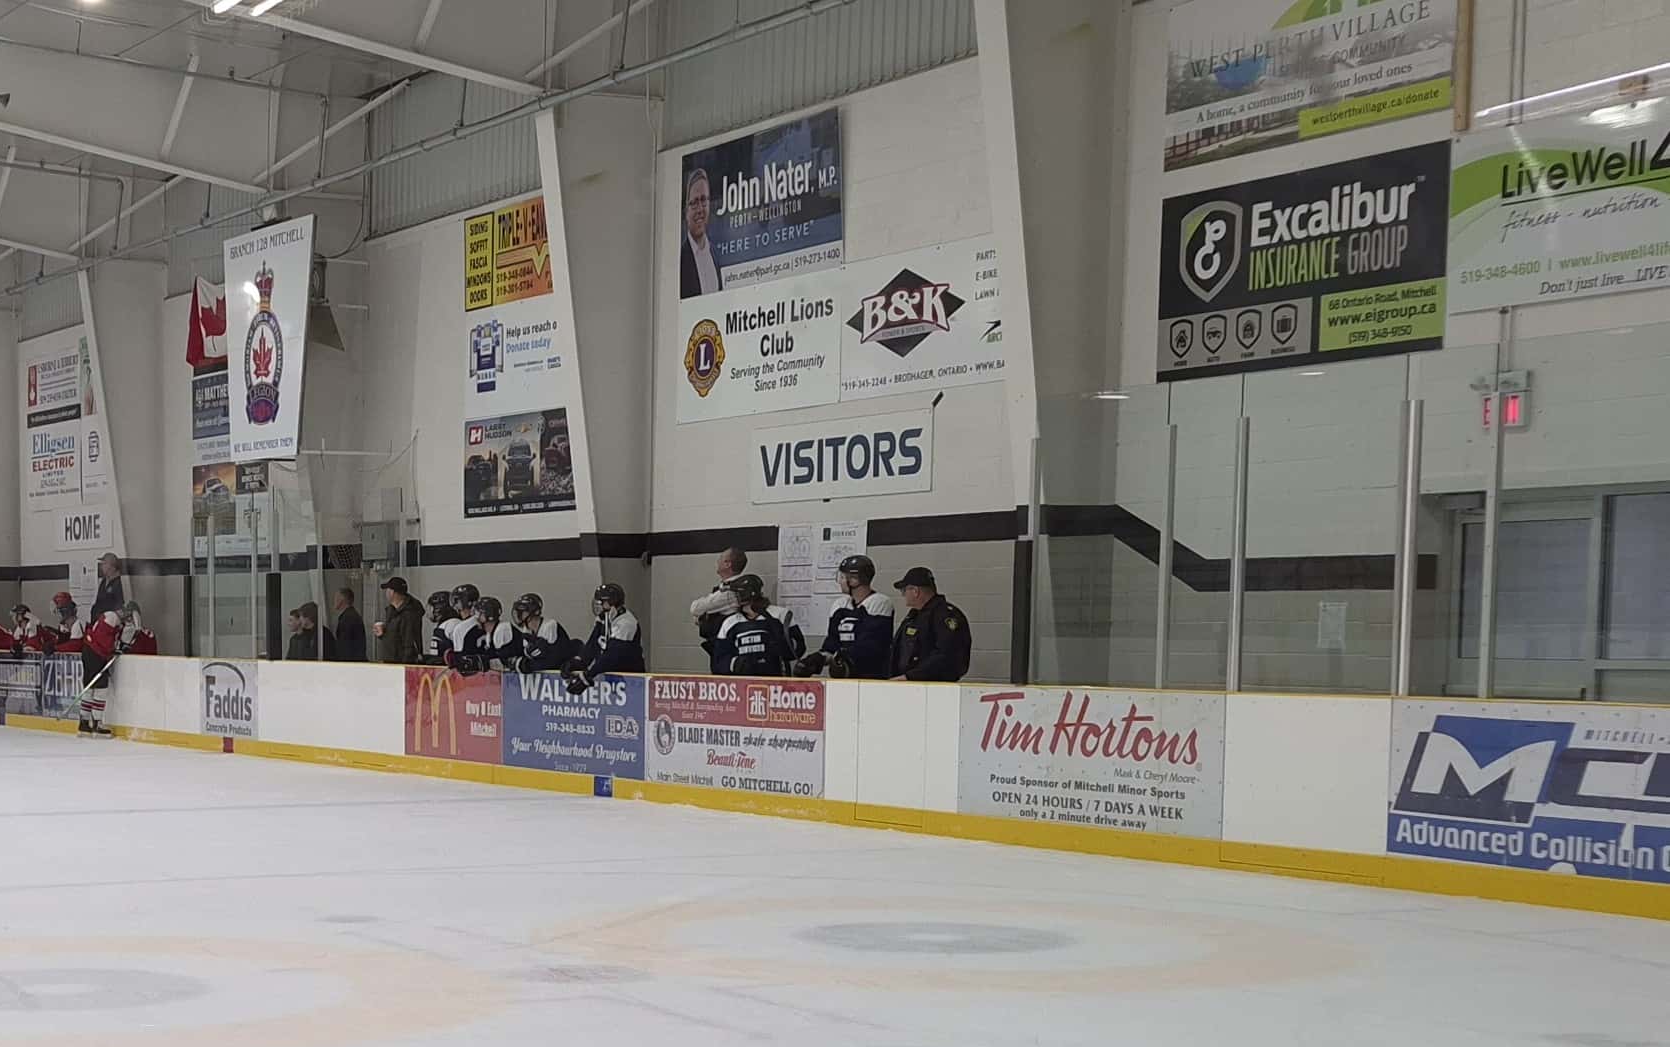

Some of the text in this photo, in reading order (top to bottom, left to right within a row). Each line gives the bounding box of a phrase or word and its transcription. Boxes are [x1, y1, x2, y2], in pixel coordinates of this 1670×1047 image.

[1190, 44, 1245, 78] WEST
[1330, 0, 1430, 41] VILLAGE
[1196, 112, 1205, 124] A
[1247, 88, 1307, 114] community
[1353, 68, 1384, 86] loved
[1386, 62, 1413, 78] ones
[717, 171, 760, 216] John
[818, 166, 838, 190] M.P.
[1250, 181, 1416, 247] Excalibur
[230, 240, 255, 260] BRANCH
[270, 226, 305, 248] MITCHELL
[755, 232, 770, 246] TO
[1248, 225, 1409, 291] INSURANCE GROUP
[1341, 293, 1374, 309] Ontario
[1401, 284, 1437, 302] Mitchell
[1576, 275, 1599, 294] just
[725, 298, 834, 335] Mitchell Lions
[860, 283, 951, 344] B&K
[1327, 302, 1437, 328] www.eigroup.ca
[506, 325, 521, 339] Help
[522, 326, 531, 336] us
[532, 320, 551, 334] reach
[698, 343, 711, 371] L
[760, 331, 794, 357] Club
[730, 353, 826, 379] Serving the Community
[938, 363, 967, 377] ONTARIO
[251, 382, 277, 399] LEGION
[754, 374, 798, 392] Since 1936
[32, 431, 75, 457] Elligsen
[760, 427, 923, 487] VISITORS
[32, 456, 75, 472] ELECTRIC
[65, 514, 100, 541] HOME
[205, 675, 252, 722] Faddis
[654, 680, 740, 702] FAUST BROS.
[769, 685, 816, 710] Home
[542, 704, 601, 719] PHARMACY
[769, 710, 816, 724] hardware
[229, 723, 252, 737] Products
[678, 726, 705, 745] BLADE
[706, 728, 741, 748] MASTER
[767, 734, 817, 753] sharpening
[980, 690, 1199, 766] Tim Hortons
[511, 736, 637, 765] Your Neighbourhood Drugstore
[721, 775, 814, 797] GO MITCHELL GO!
[990, 773, 1186, 801] Proud Sponsor of Mitchell Minor Sports
[992, 791, 1022, 804] OPEN
[1025, 793, 1039, 806] 24
[1042, 795, 1083, 811] HOURS
[1094, 798, 1100, 811] 7
[1104, 800, 1134, 815] DAYS
[1137, 803, 1147, 816] A
[1148, 805, 1184, 820] WEEK
[1019, 808, 1039, 821] only
[1058, 811, 1092, 824] minute
[1094, 814, 1119, 828] drive
[1120, 818, 1148, 831] away
[1396, 818, 1656, 872] Advanced Collision
